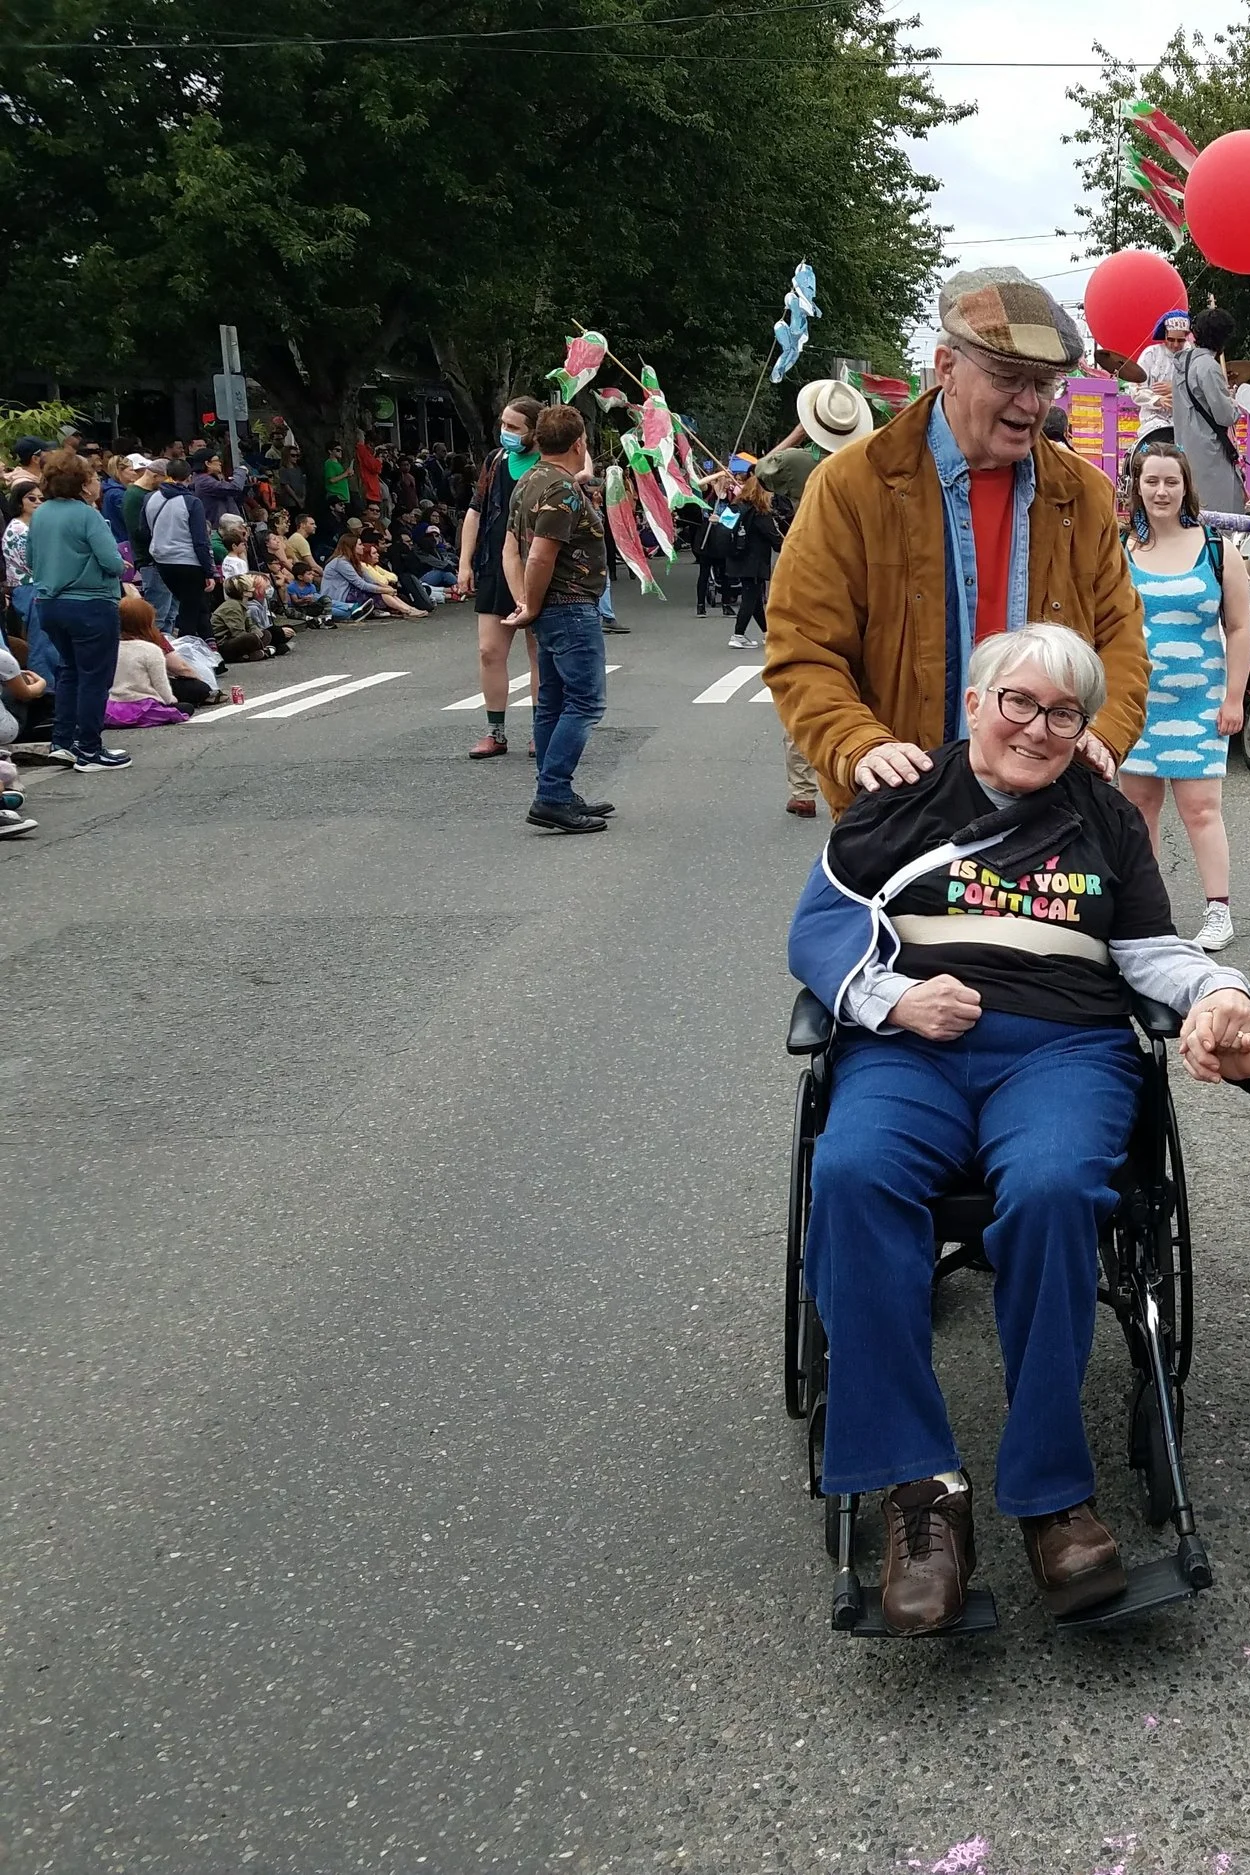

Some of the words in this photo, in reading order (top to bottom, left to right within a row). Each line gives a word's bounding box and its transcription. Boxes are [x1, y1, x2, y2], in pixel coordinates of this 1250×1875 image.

[949, 859, 979, 880] IS
[1033, 873, 1103, 896] YOUR
[947, 880, 1081, 922] POLITICAL
